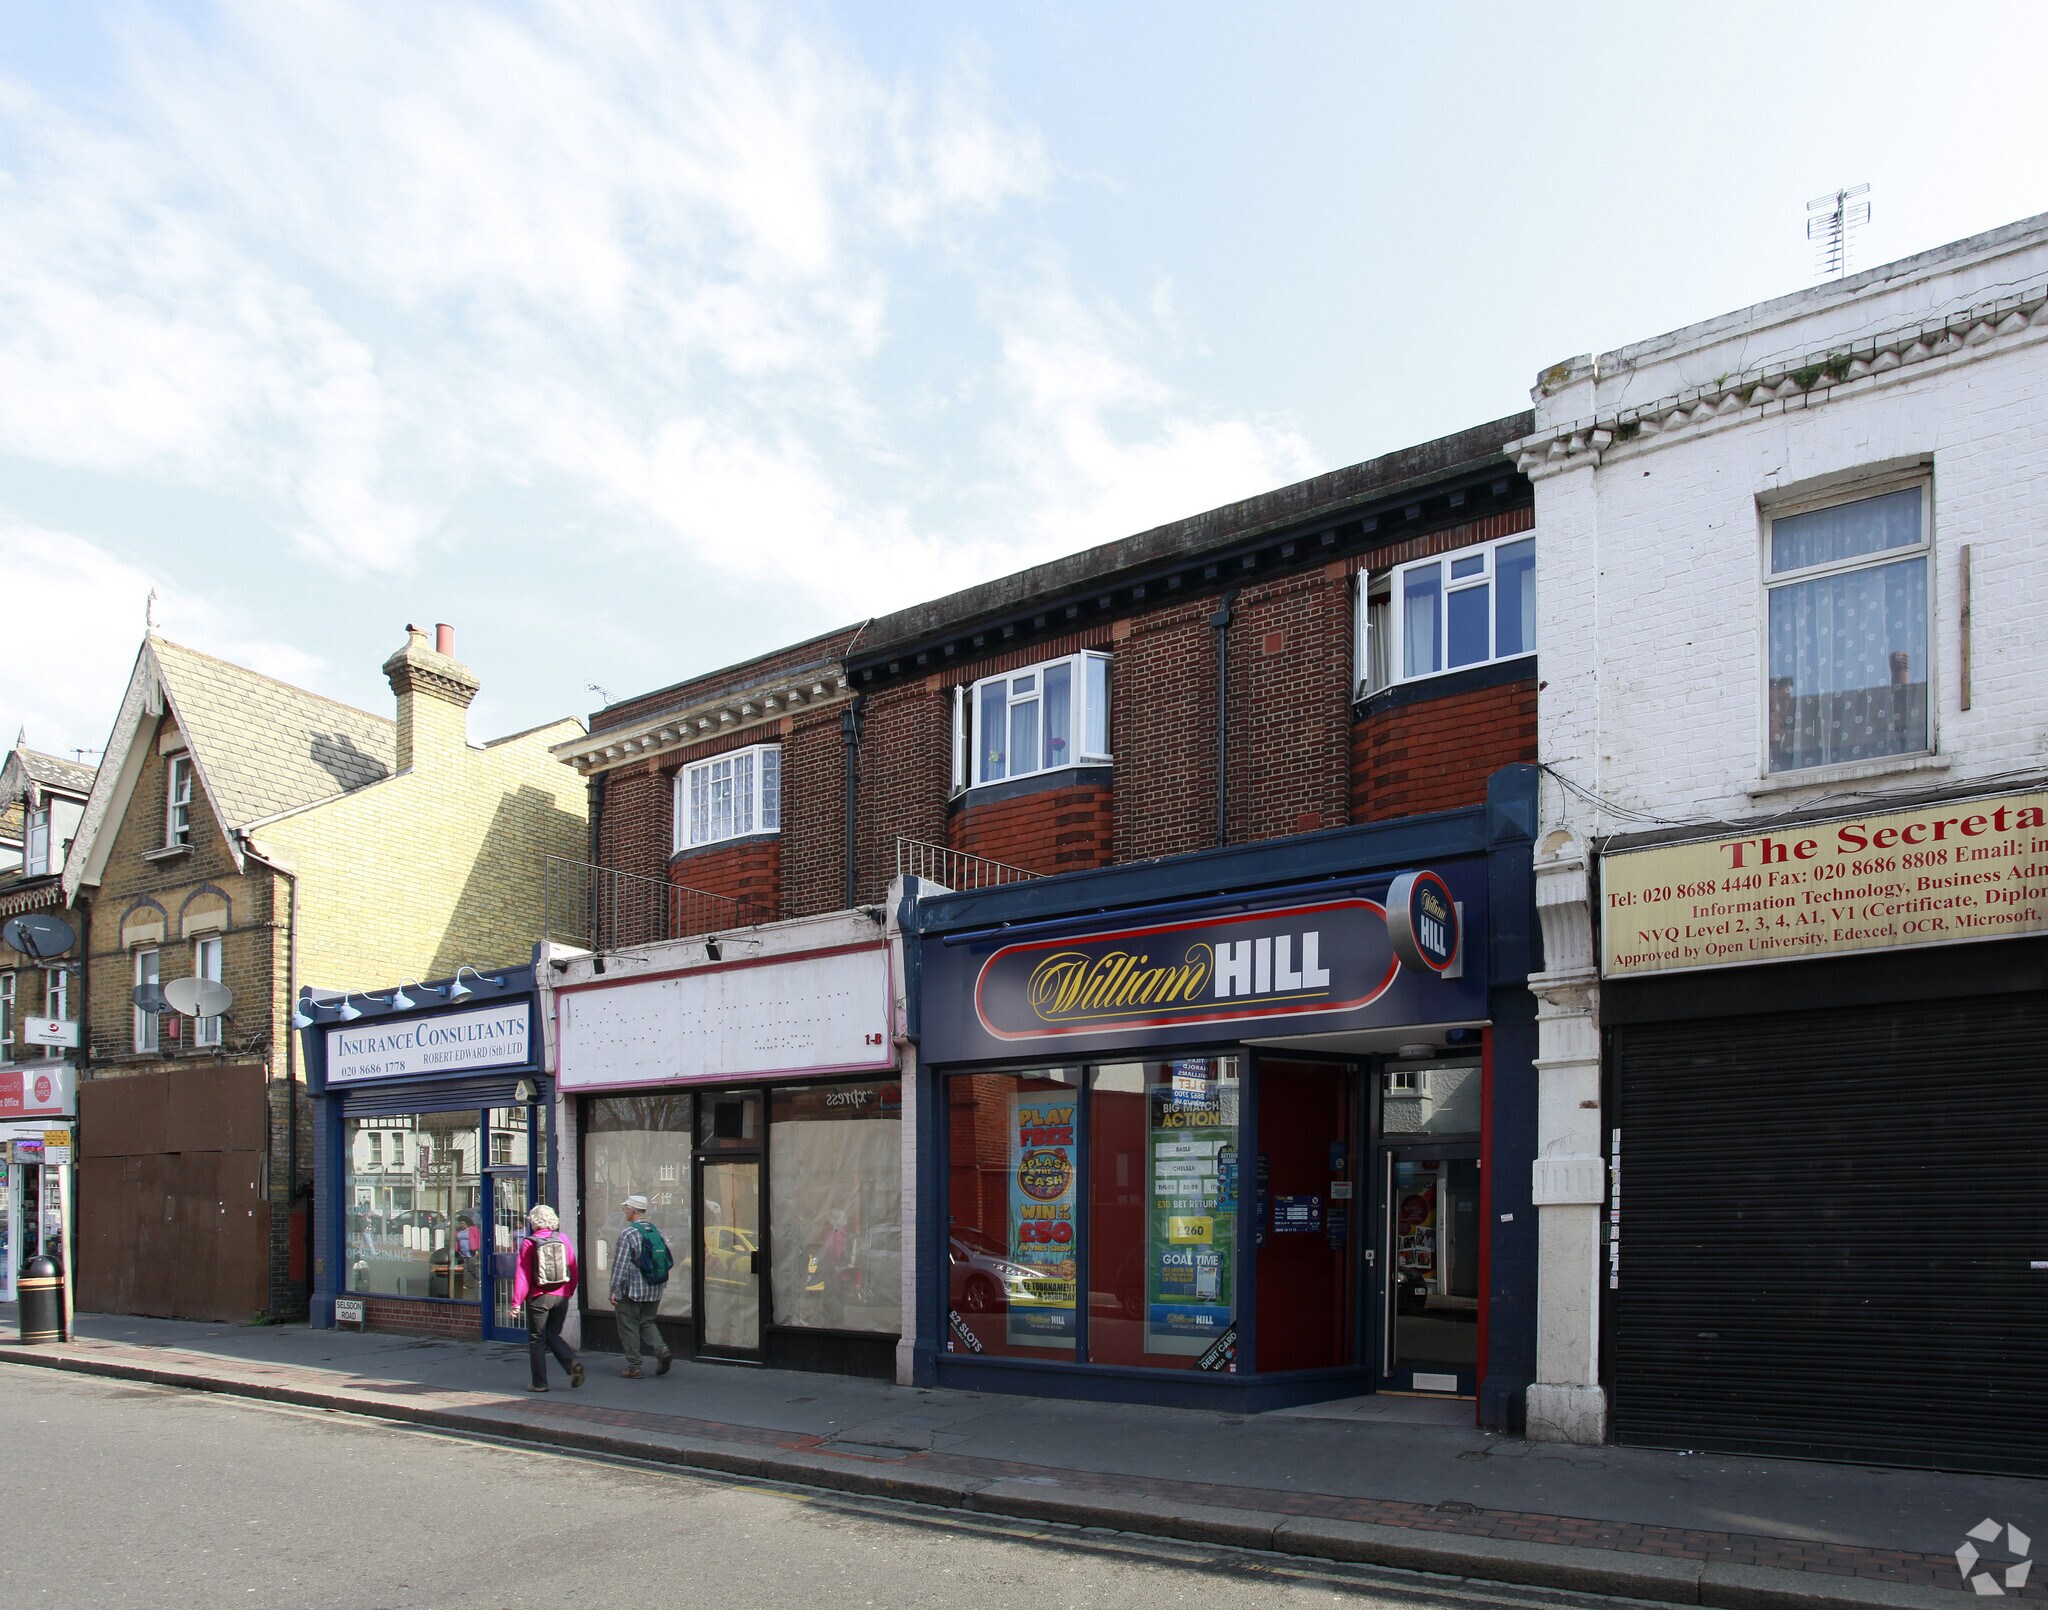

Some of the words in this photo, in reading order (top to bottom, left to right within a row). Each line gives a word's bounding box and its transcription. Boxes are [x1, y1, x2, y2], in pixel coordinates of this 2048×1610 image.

[1720, 838, 1818, 870] The
[1837, 805, 2047, 855] Secreta
[1608, 892, 1637, 908] Tel:
[1643, 886, 1671, 903] 020
[1677, 880, 1716, 898] 8688
[1721, 874, 1762, 892] 4440
[1768, 871, 1808, 887] Fax:
[1814, 863, 1846, 881] 020
[1852, 856, 1896, 876] 8686
[1902, 849, 1948, 870] 8808
[1955, 840, 2023, 863] Email:
[1692, 895, 1796, 918] Information
[1802, 882, 1911, 905] Technology,
[1917, 869, 2001, 891] Business
[1421, 889, 1447, 921] William
[1638, 926, 1679, 944] NVQ
[1685, 921, 1730, 938] Level
[1735, 920, 1750, 934] 2,
[1755, 917, 1770, 932] 3,
[1775, 914, 1791, 928] 4,
[1795, 911, 1825, 926] A1,
[1831, 906, 1855, 921] V1
[1862, 894, 1978, 921] (Certificate,
[1421, 914, 1446, 956] HILL
[1614, 948, 1680, 968] Approved
[1684, 945, 1700, 960] by
[1705, 942, 1744, 957] Open
[1749, 932, 1828, 950] University,
[1833, 924, 1898, 942] Edexcel,
[1903, 918, 1949, 934] OCR,
[1955, 908, 2042, 929] Microsoft,
[1026, 943, 1213, 1018] William
[1214, 932, 1330, 998] HILL
[338, 1033, 414, 1056] INSURANCE
[416, 1018, 525, 1047] CONSULTANTS
[423, 1053, 453, 1064] ROBERT
[455, 1048, 488, 1062] EDWARD
[507, 1042, 523, 1055] LTD
[342, 1066, 357, 1077] 020
[360, 1063, 382, 1075] 8686
[385, 1061, 406, 1072] 1778
[1163, 1103, 1180, 1114] BIG
[1183, 1101, 1220, 1112] MATCH
[1018, 1108, 1074, 1128] PLAY
[1162, 1111, 1220, 1128] ACTION
[1020, 1127, 1073, 1147] FREE
[1020, 1157, 1072, 1173] SPLASH
[1024, 1174, 1063, 1186] CASH
[1020, 1204, 1056, 1220] WIN
[1058, 1204, 1070, 1212] UP
[1158, 1200, 1171, 1209] £10
[1173, 1200, 1187, 1208] BET
[1058, 1212, 1070, 1220] TO
[1018, 1222, 1072, 1243] £50
[1162, 1254, 1192, 1265] GOAL
[1196, 1254, 1218, 1266] TIME
[1032, 1282, 1076, 1292] TOURNAMENT
[336, 1300, 362, 1310] SELSDON
[341, 1311, 356, 1320] ROAD
[1051, 1316, 1065, 1324] HILL
[1196, 1315, 1214, 1325] HILL
[949, 1310, 961, 1326] £2
[960, 1322, 982, 1352] SLOTS
[1201, 1350, 1220, 1370] DEBIT
[1218, 1332, 1237, 1352] CARD
